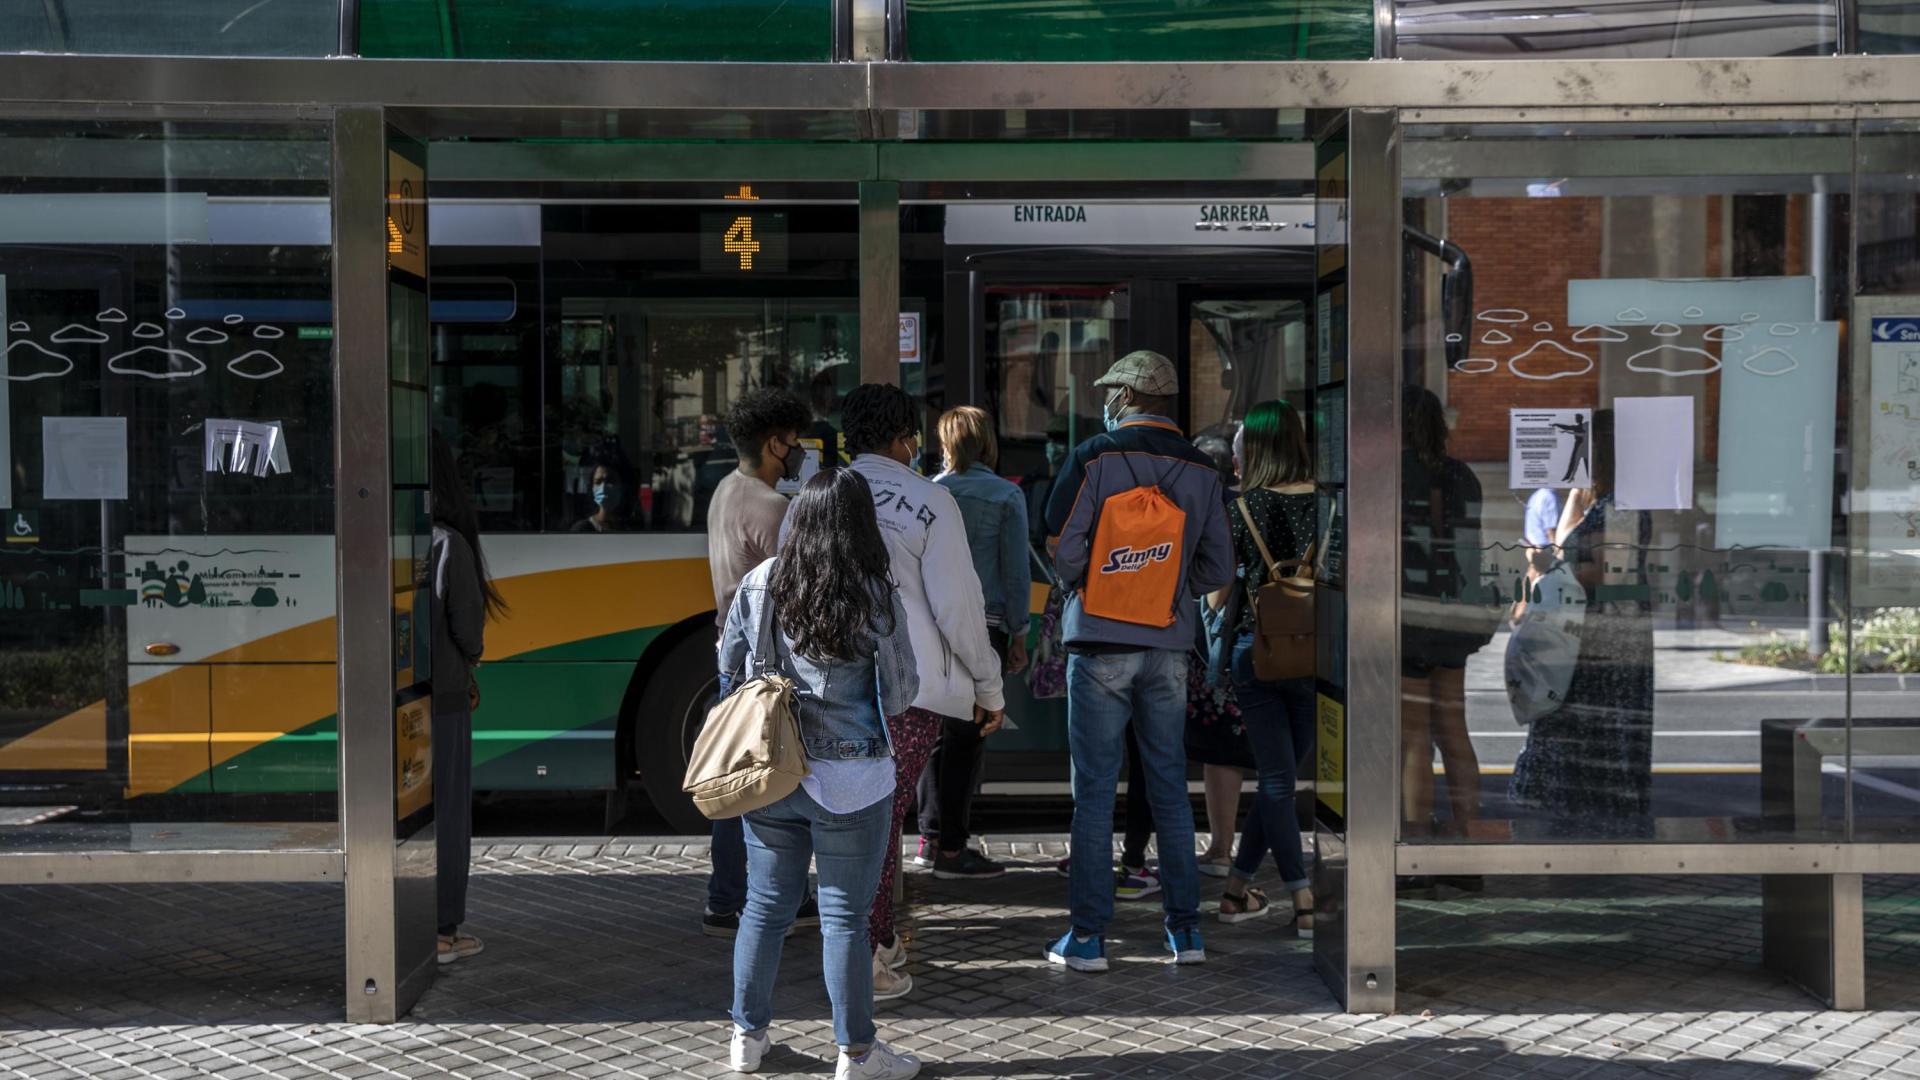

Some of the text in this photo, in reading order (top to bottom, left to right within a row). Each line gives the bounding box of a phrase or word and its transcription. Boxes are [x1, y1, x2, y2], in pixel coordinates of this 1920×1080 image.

[1013, 205, 1087, 223] ENTRADA
[1200, 205, 1270, 222] SARRERA
[724, 216, 760, 270] 4
[1101, 543, 1172, 573] Sunny
